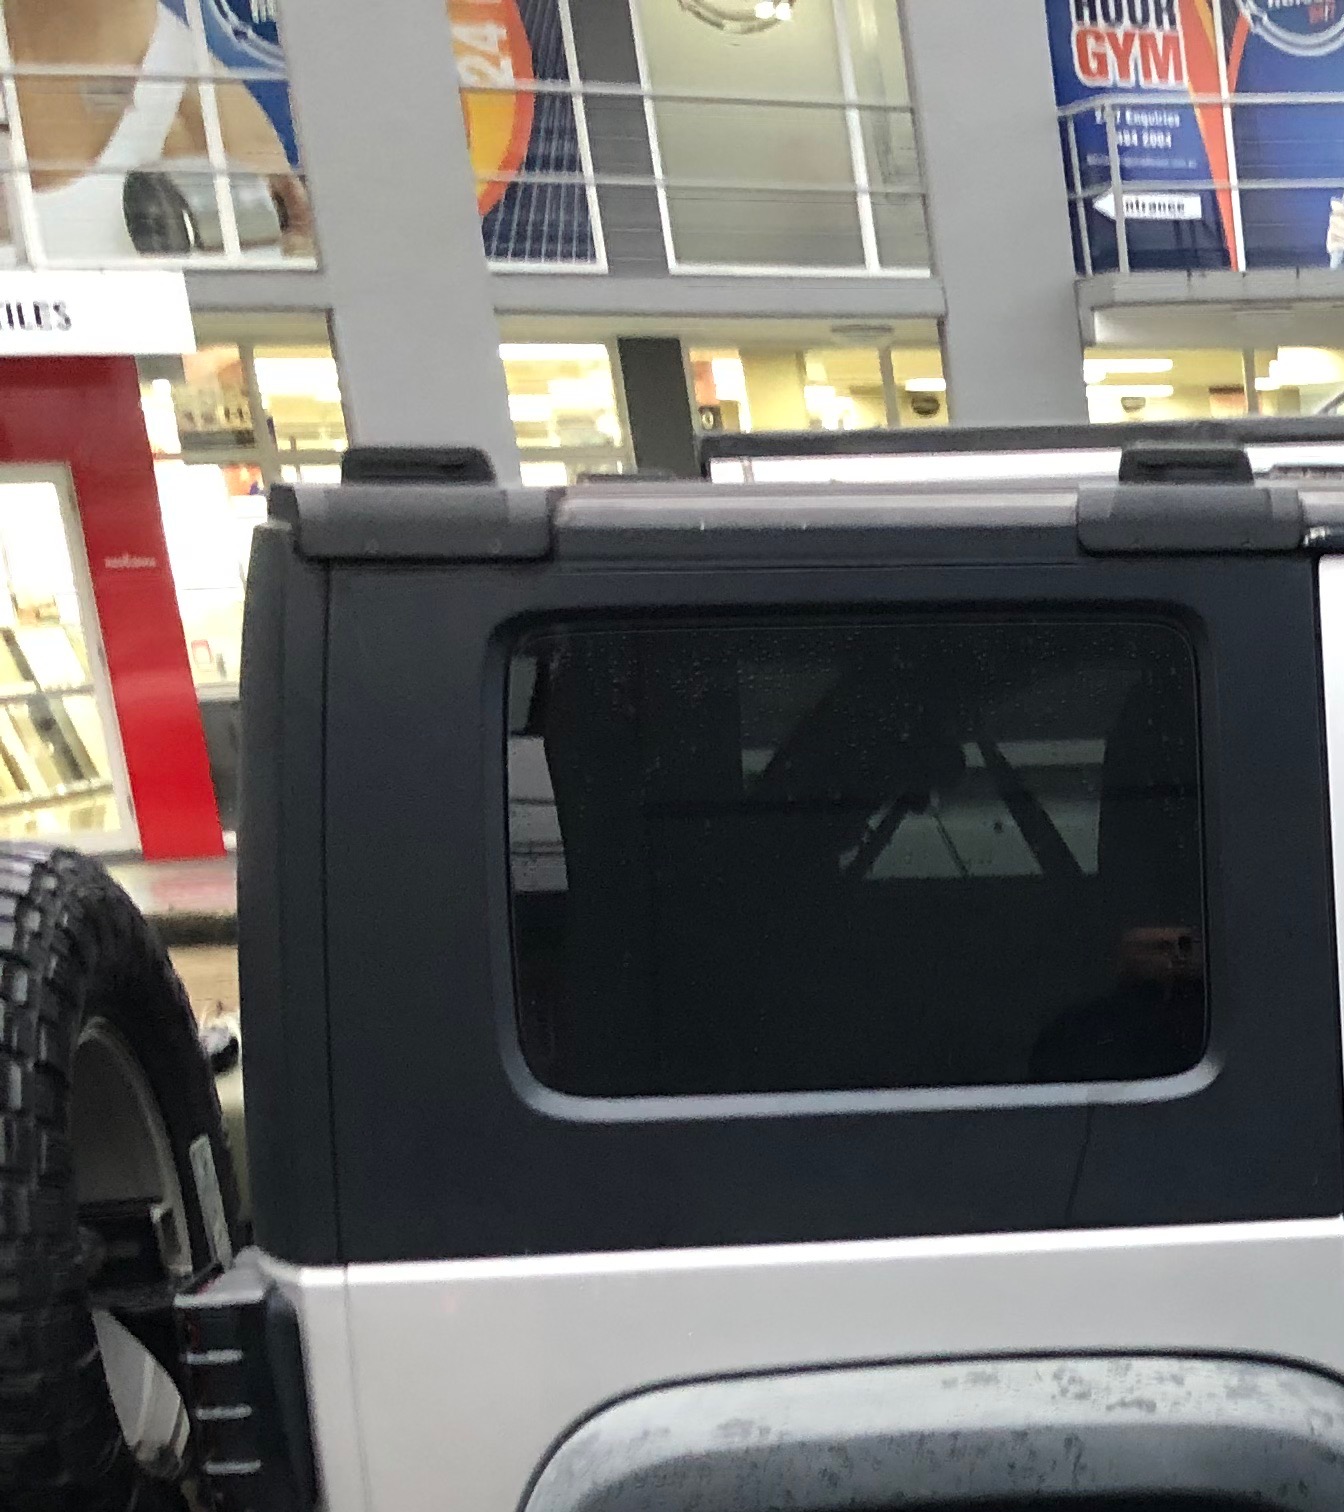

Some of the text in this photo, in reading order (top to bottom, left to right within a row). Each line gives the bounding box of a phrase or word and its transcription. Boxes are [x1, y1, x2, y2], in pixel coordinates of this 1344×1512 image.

[1076, 29, 1184, 84] GYM
[1124, 199, 1185, 214] ntrance
[0, 300, 72, 331] ILES
